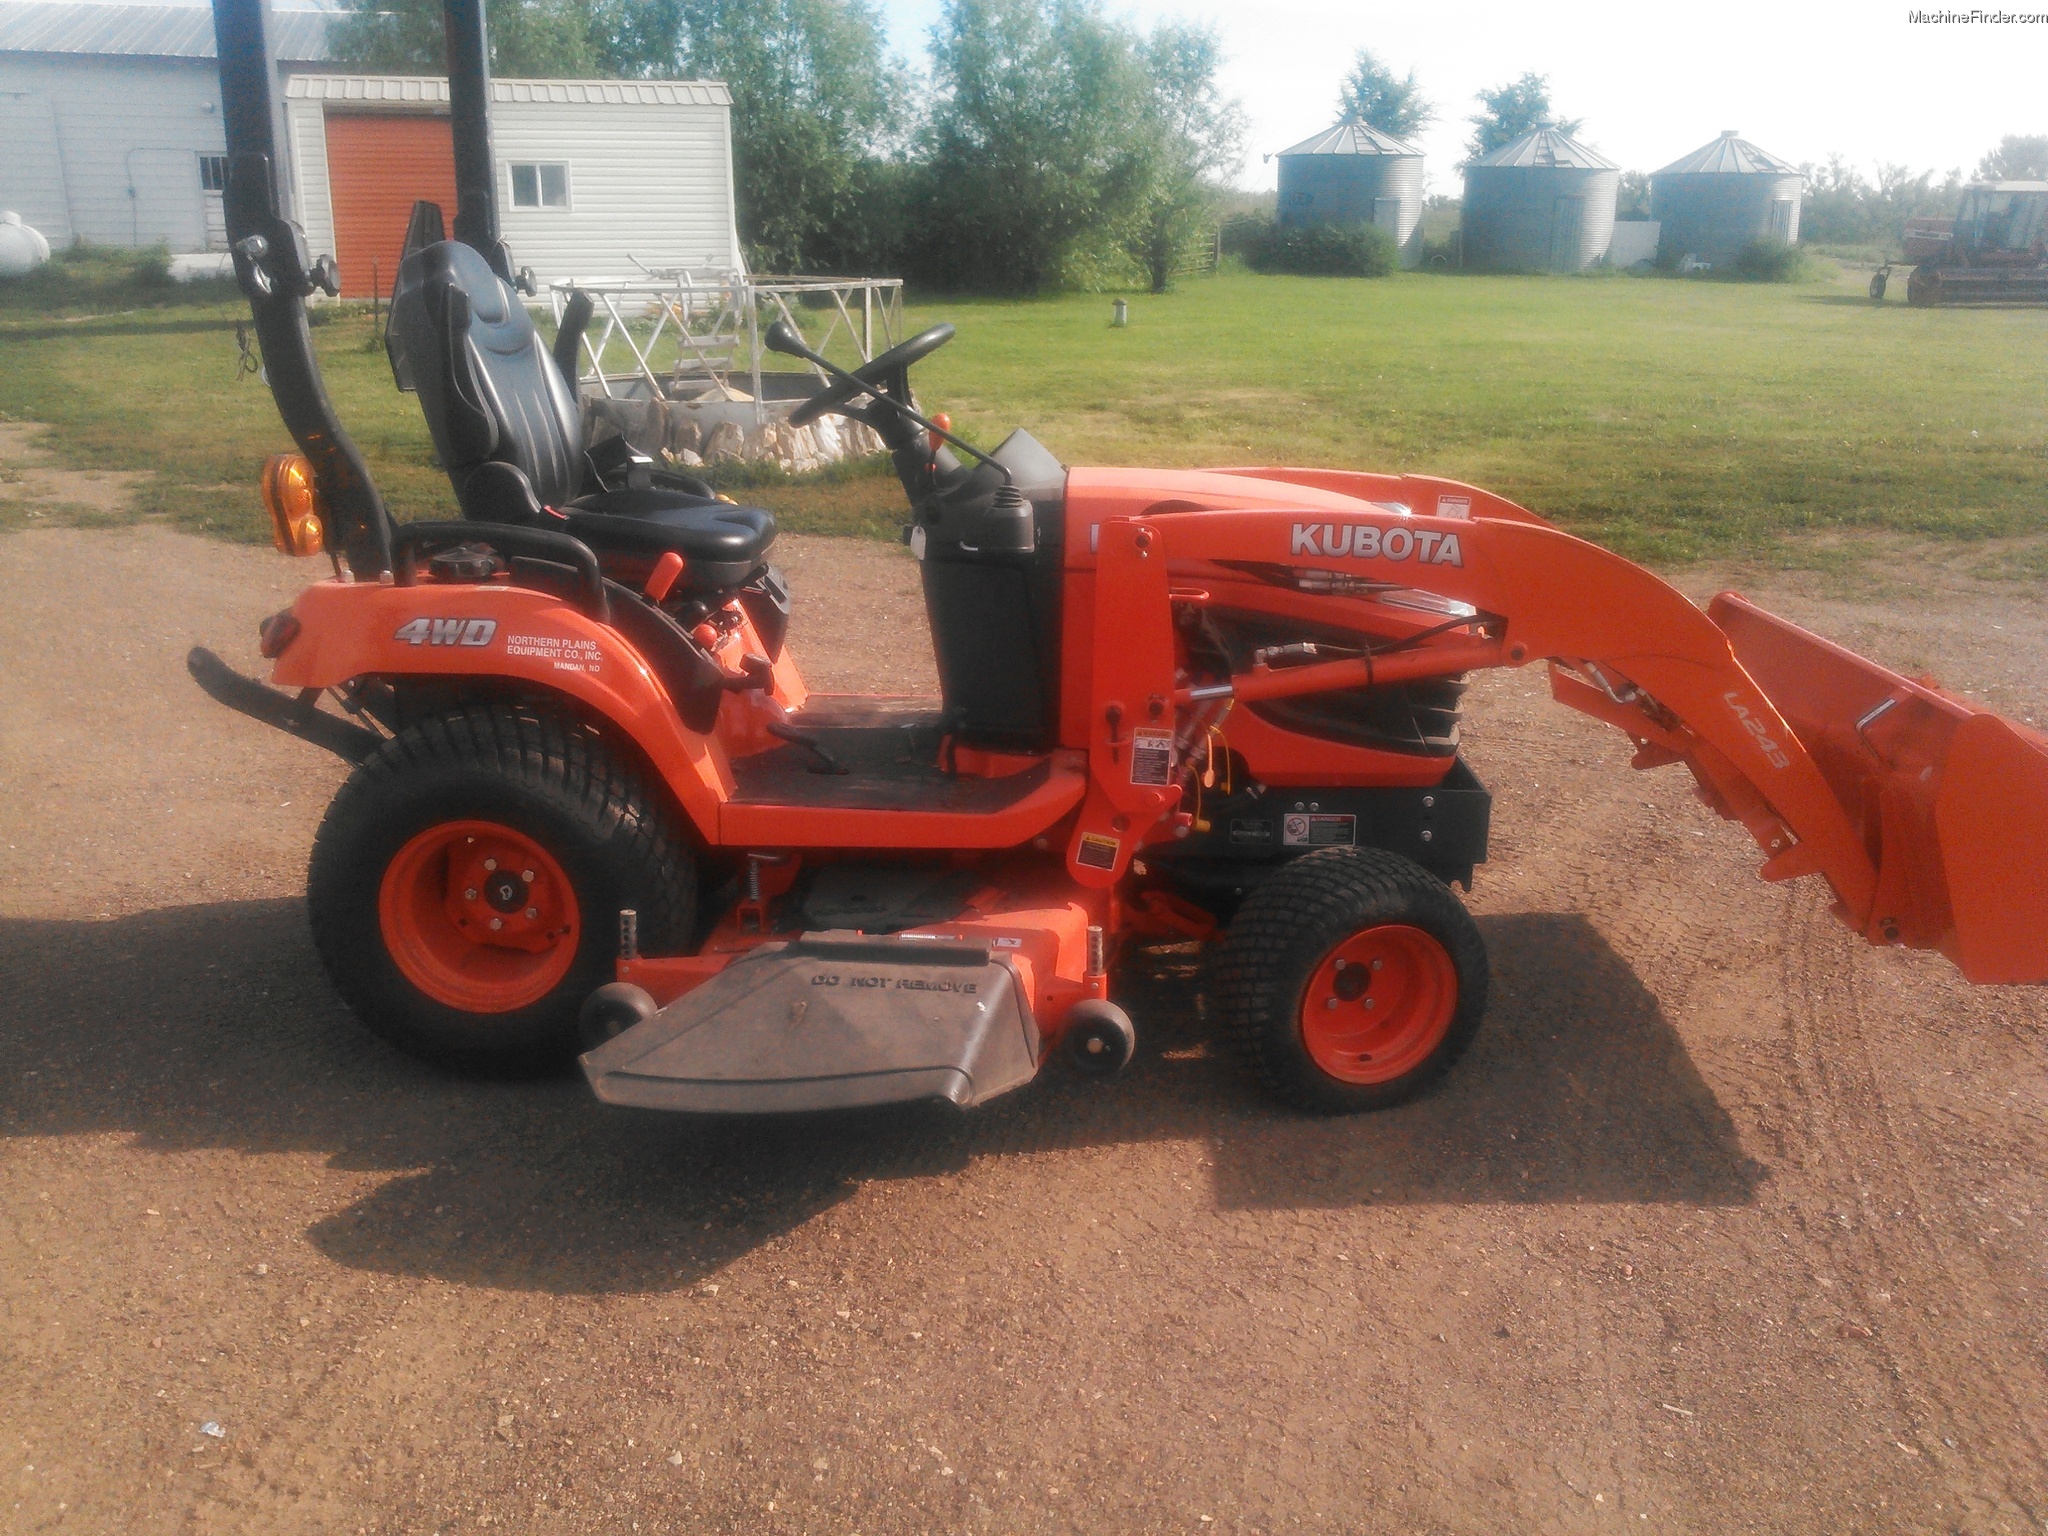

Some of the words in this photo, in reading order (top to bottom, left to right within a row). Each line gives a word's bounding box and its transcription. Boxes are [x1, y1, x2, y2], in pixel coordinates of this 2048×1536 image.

[1290, 522, 1464, 568] KUBOTA
[394, 617, 498, 647] 4WD
[507, 635, 560, 648] NORTHERN
[562, 639, 597, 651] PLAINS
[507, 645, 562, 658] EQUIPMENT
[584, 651, 604, 661] INC.
[589, 664, 600, 672] ND
[1722, 692, 1790, 769] LA243
[810, 975, 840, 986] DO
[850, 976, 892, 989] NOT
[896, 979, 978, 994] REMOVE
